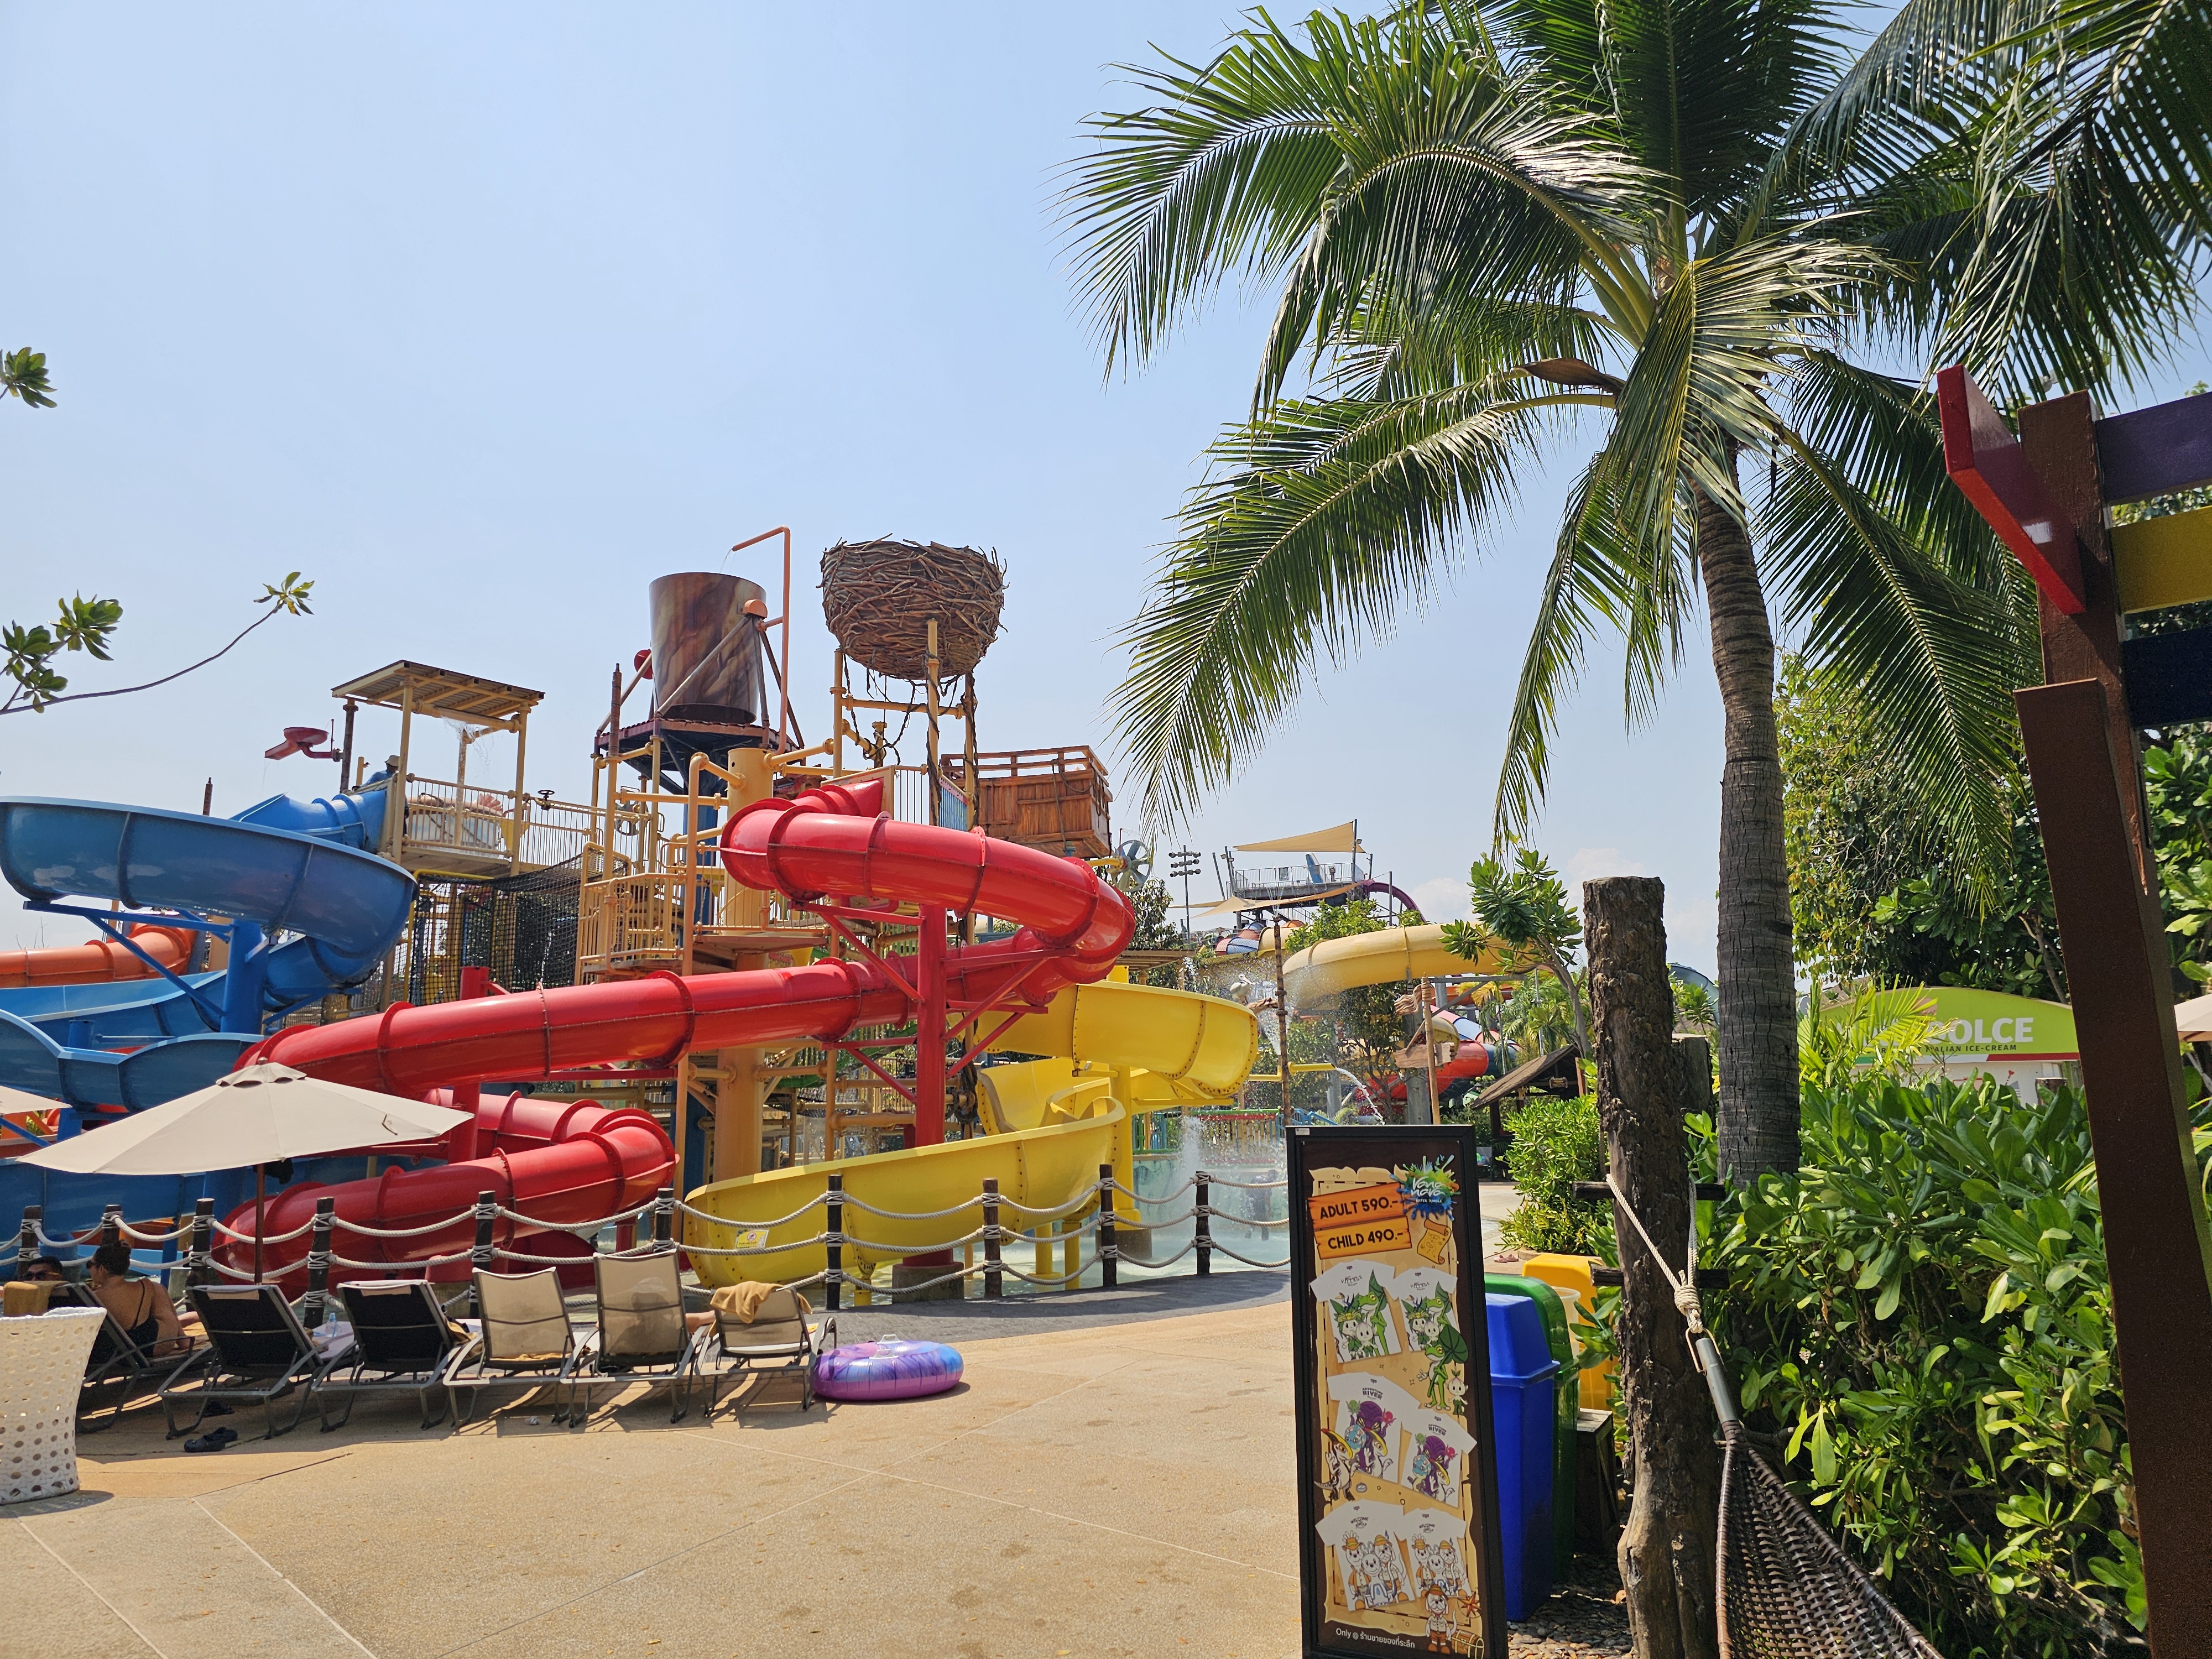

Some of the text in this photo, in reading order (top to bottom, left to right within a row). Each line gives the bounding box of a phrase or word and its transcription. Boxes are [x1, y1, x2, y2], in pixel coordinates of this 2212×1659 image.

[1927, 1017, 2034, 1045] DOLCE
[1320, 1196, 1398, 1219] ADULT 590.-
[1328, 1228, 1404, 1249] CHILD 490.-
[1363, 1390, 1383, 1400] RIVER
[1428, 1426, 1446, 1436] RIVER
[1335, 1627, 1415, 1648] Only @ ร้านขายของที่ระลึก
